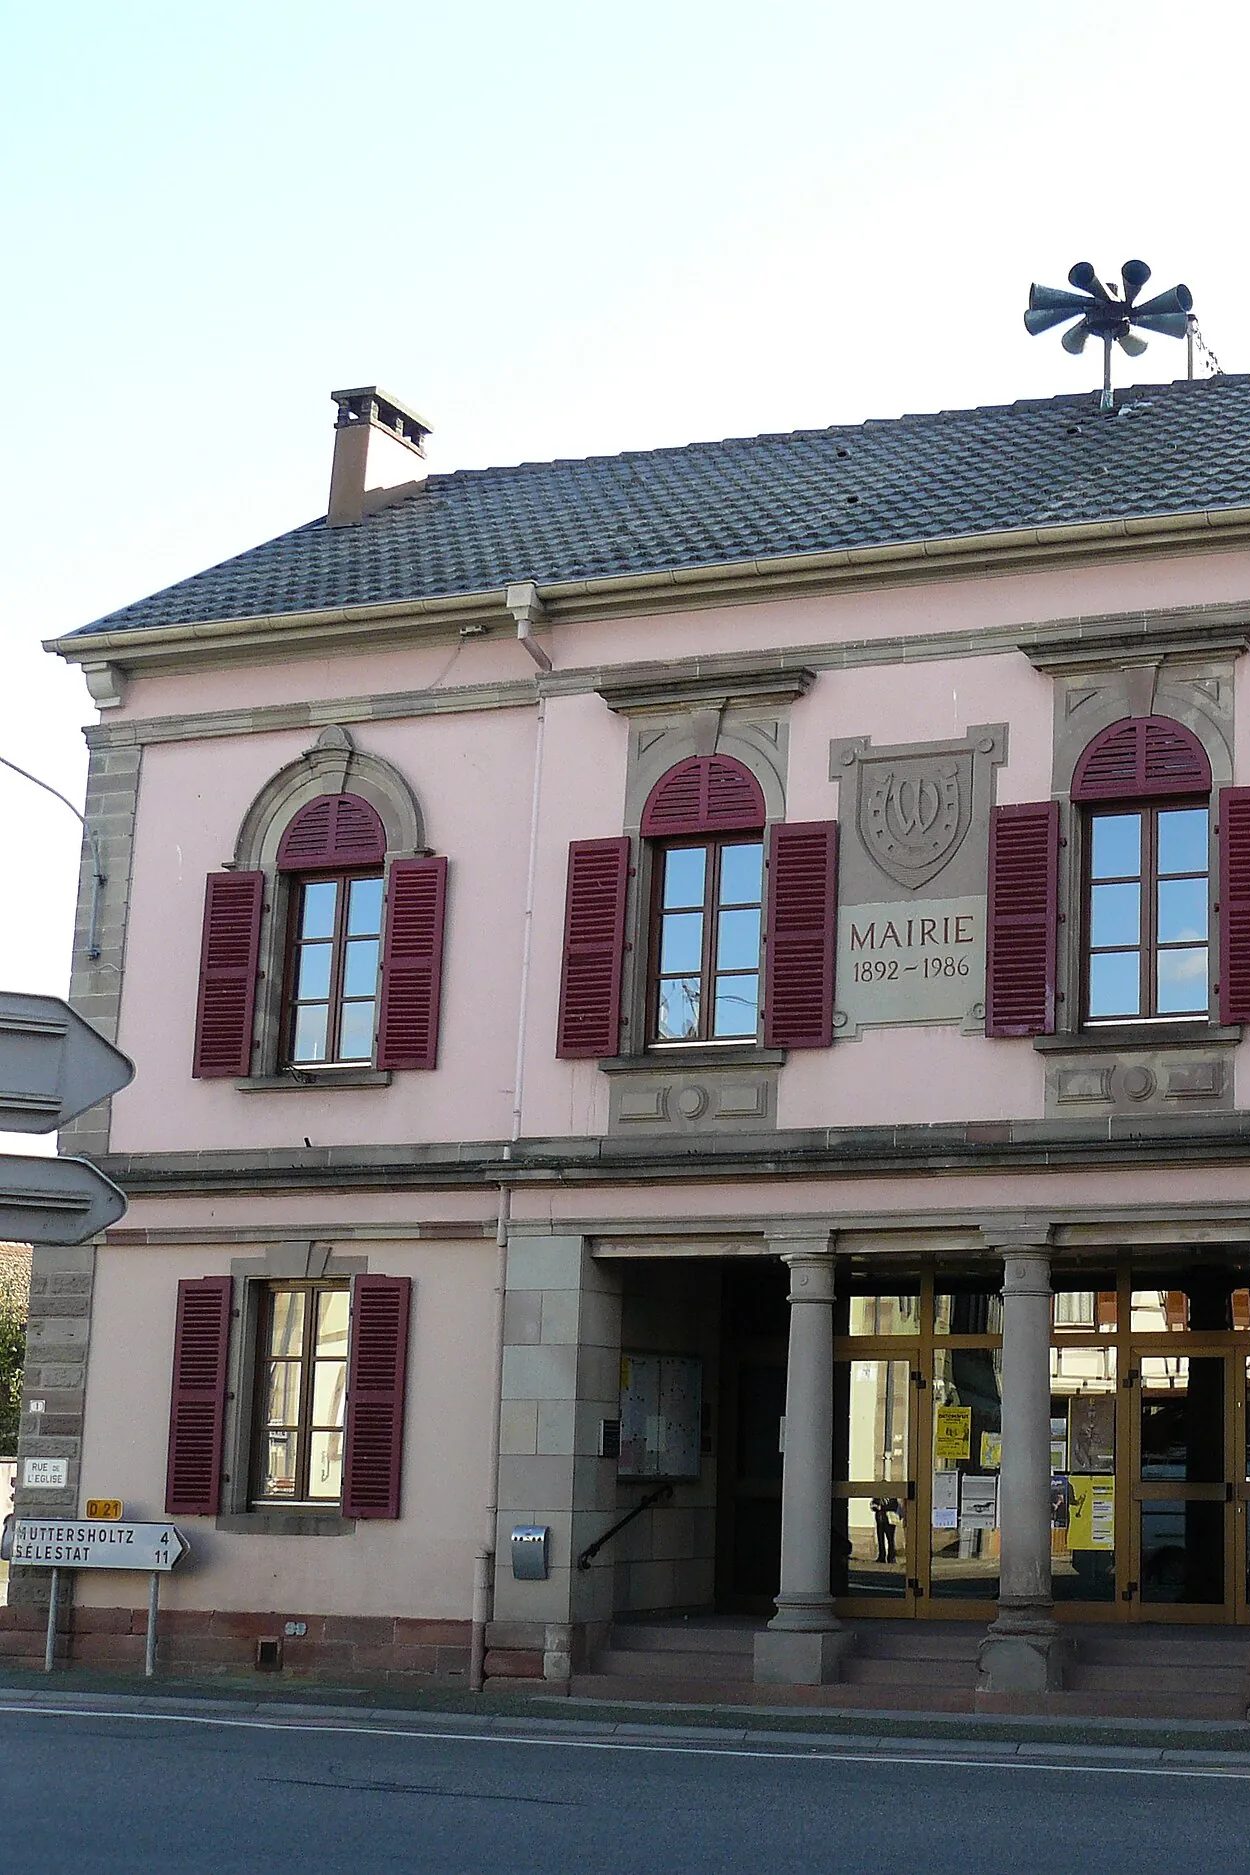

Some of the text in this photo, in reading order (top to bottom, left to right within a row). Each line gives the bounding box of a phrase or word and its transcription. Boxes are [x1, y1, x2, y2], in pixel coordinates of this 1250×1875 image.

[850, 915, 975, 951] MAIRIE
[32, 1462, 48, 1472] RUE
[28, 1474, 63, 1484] L'EGLISE
[89, 1503, 119, 1517] D 21
[18, 1526, 170, 1545] MUTTERSHOLTZ 4
[15, 1543, 169, 1564] SÉLESTAT 11
